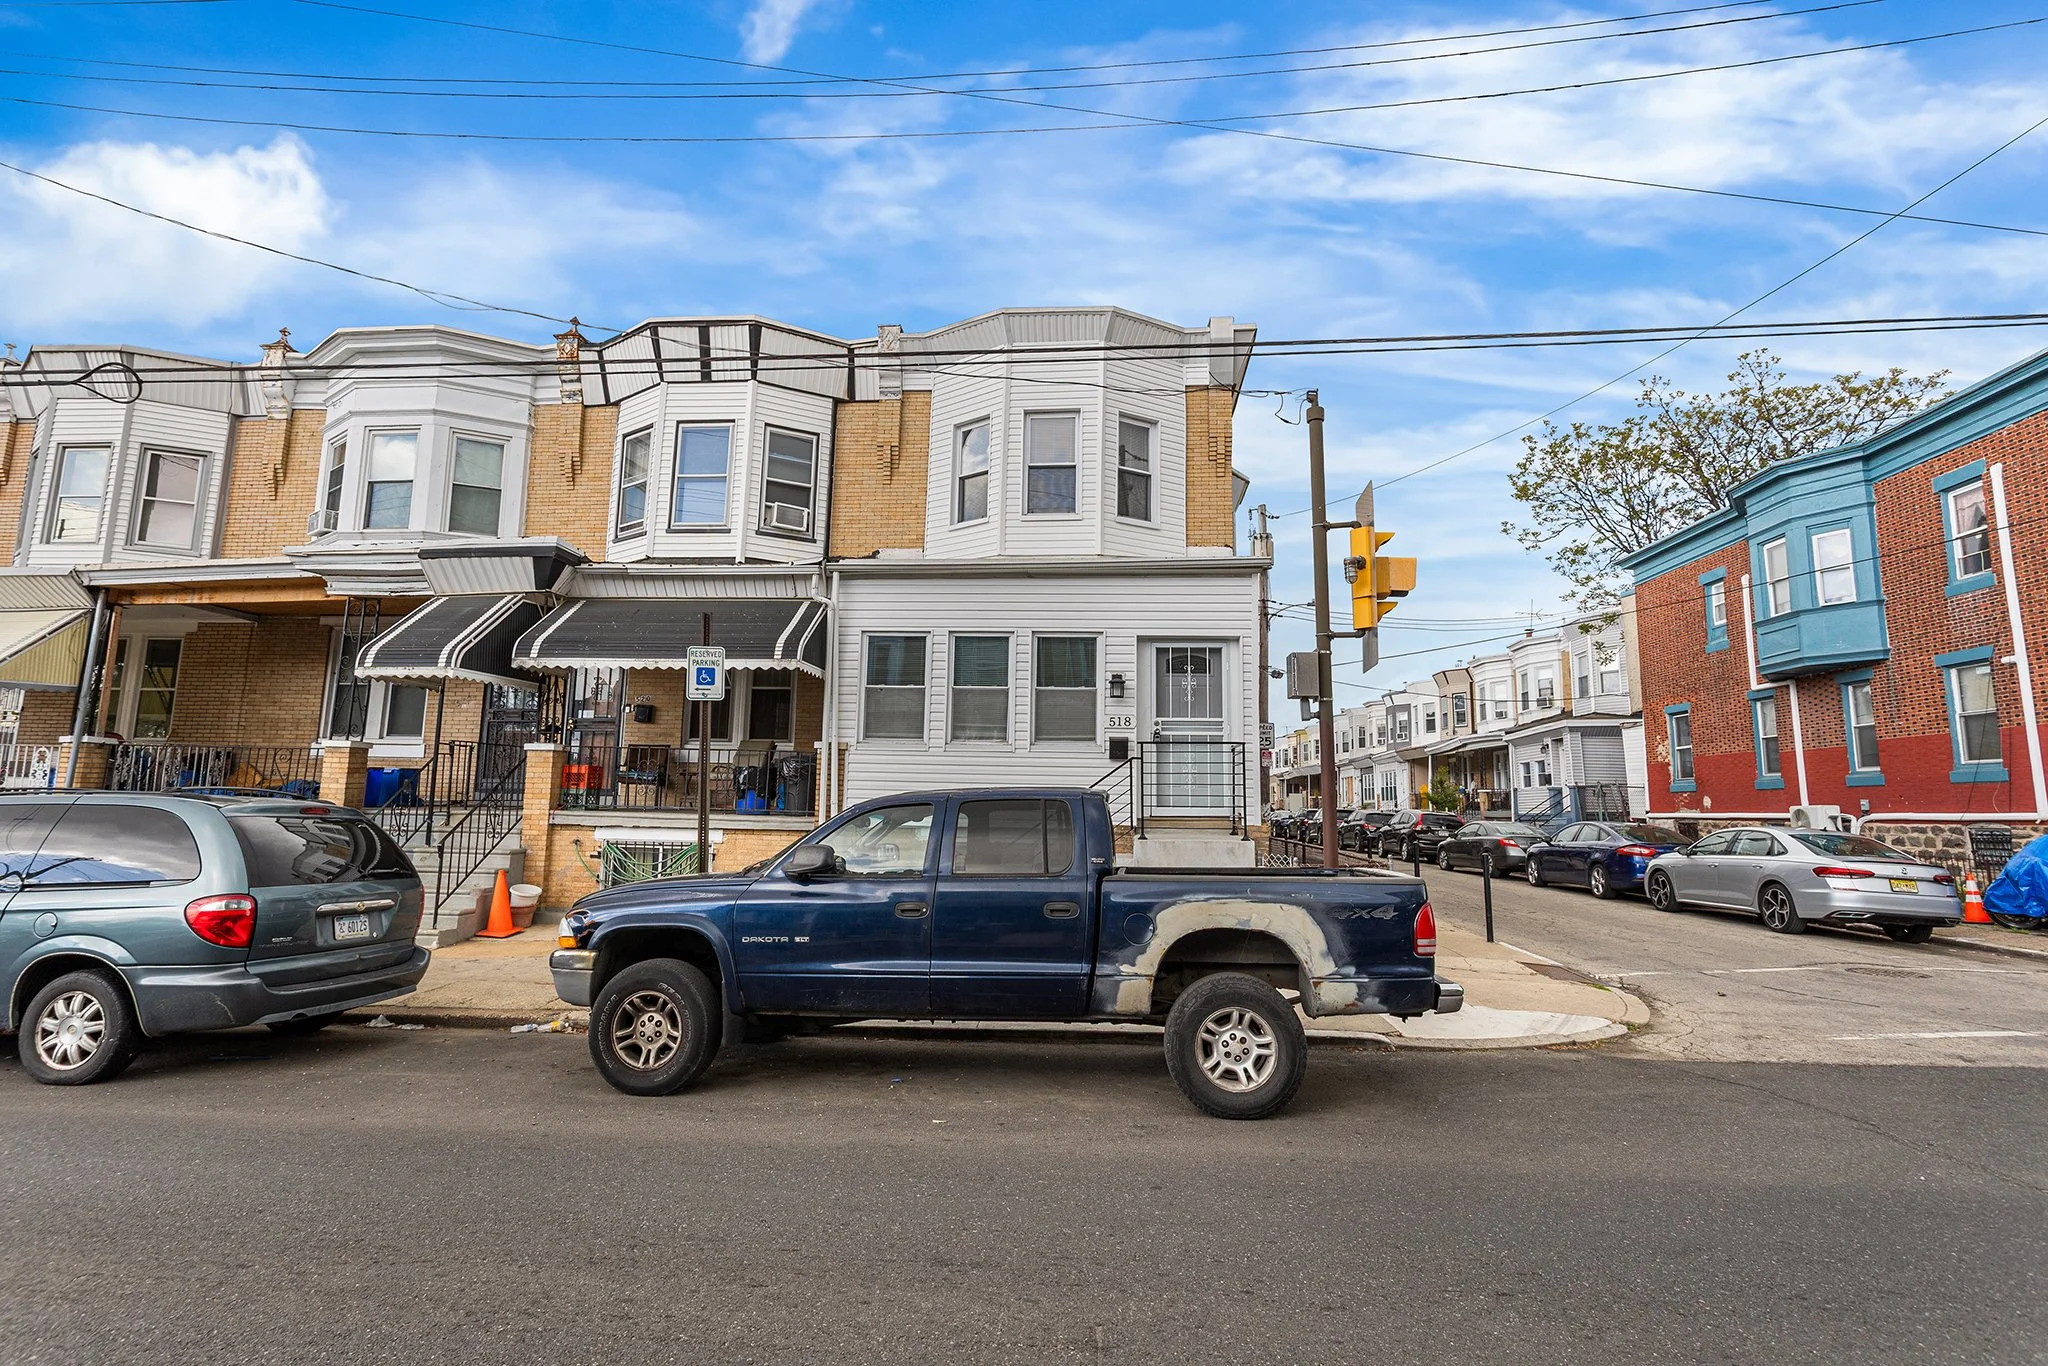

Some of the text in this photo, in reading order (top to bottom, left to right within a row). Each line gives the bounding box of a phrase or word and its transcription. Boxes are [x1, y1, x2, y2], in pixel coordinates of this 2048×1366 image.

[690, 650, 722, 658] RESERVED
[692, 659, 721, 667] PARKING
[635, 695, 651, 703] 520
[1109, 716, 1132, 727] 518
[1259, 736, 1272, 747] 25
[598, 994, 619, 1069] YOKOHAMA
